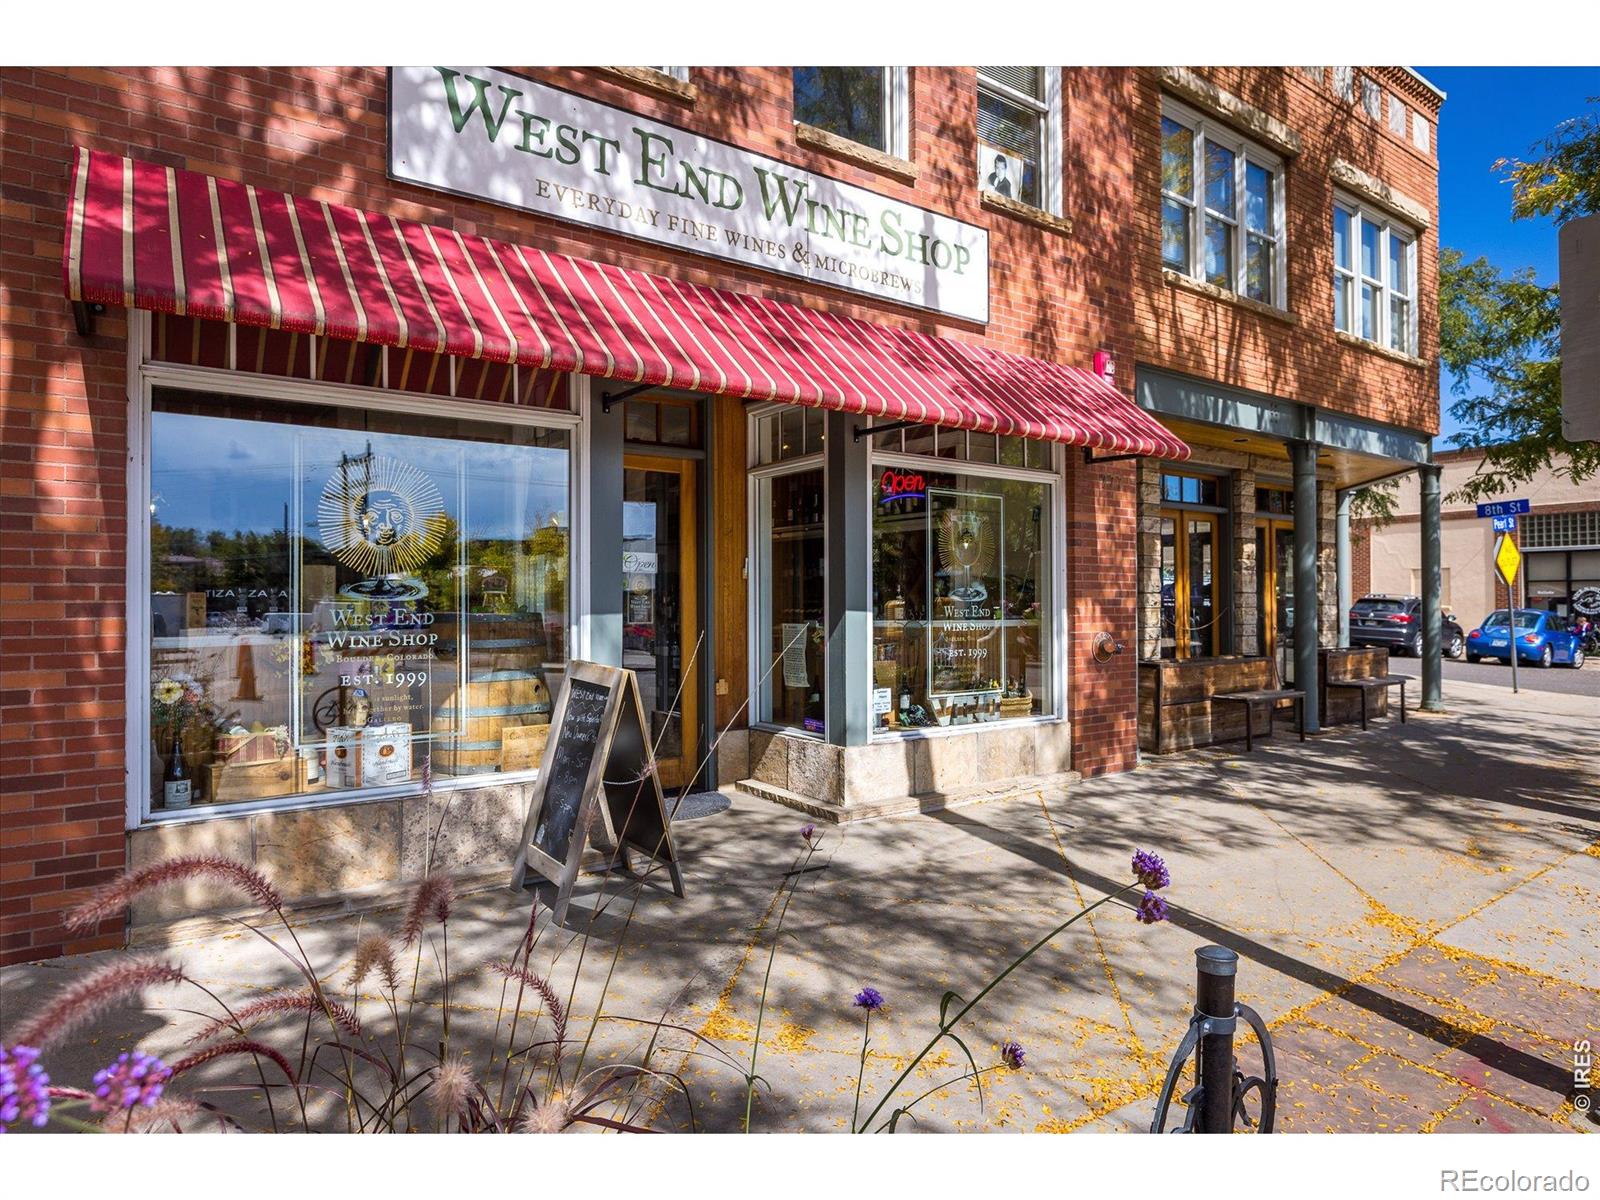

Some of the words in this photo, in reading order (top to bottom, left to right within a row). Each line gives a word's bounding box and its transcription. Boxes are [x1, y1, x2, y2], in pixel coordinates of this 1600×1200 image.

[632, 127, 743, 211] END
[753, 166, 872, 250] WINE
[879, 208, 971, 275] SHOP
[535, 178, 661, 228] EVERYDAY
[667, 213, 718, 242] FINE
[724, 228, 786, 260] WINES
[791, 241, 811, 264] &
[815, 253, 923, 295] MICROBREWS
[881, 470, 926, 496] Open
[1484, 504, 1503, 516] 8th
[1509, 502, 1521, 513] St
[1508, 517, 1515, 528] St
[624, 553, 656, 571] Open
[328, 608, 387, 627] WEST
[392, 607, 435, 626] END
[943, 605, 970, 618] WEST
[971, 605, 991, 617] END
[326, 630, 384, 648] WINE
[388, 629, 438, 646] SHOP
[968, 647, 988, 659] 1999
[340, 674, 379, 687] EST.
[385, 671, 428, 689] 1999
